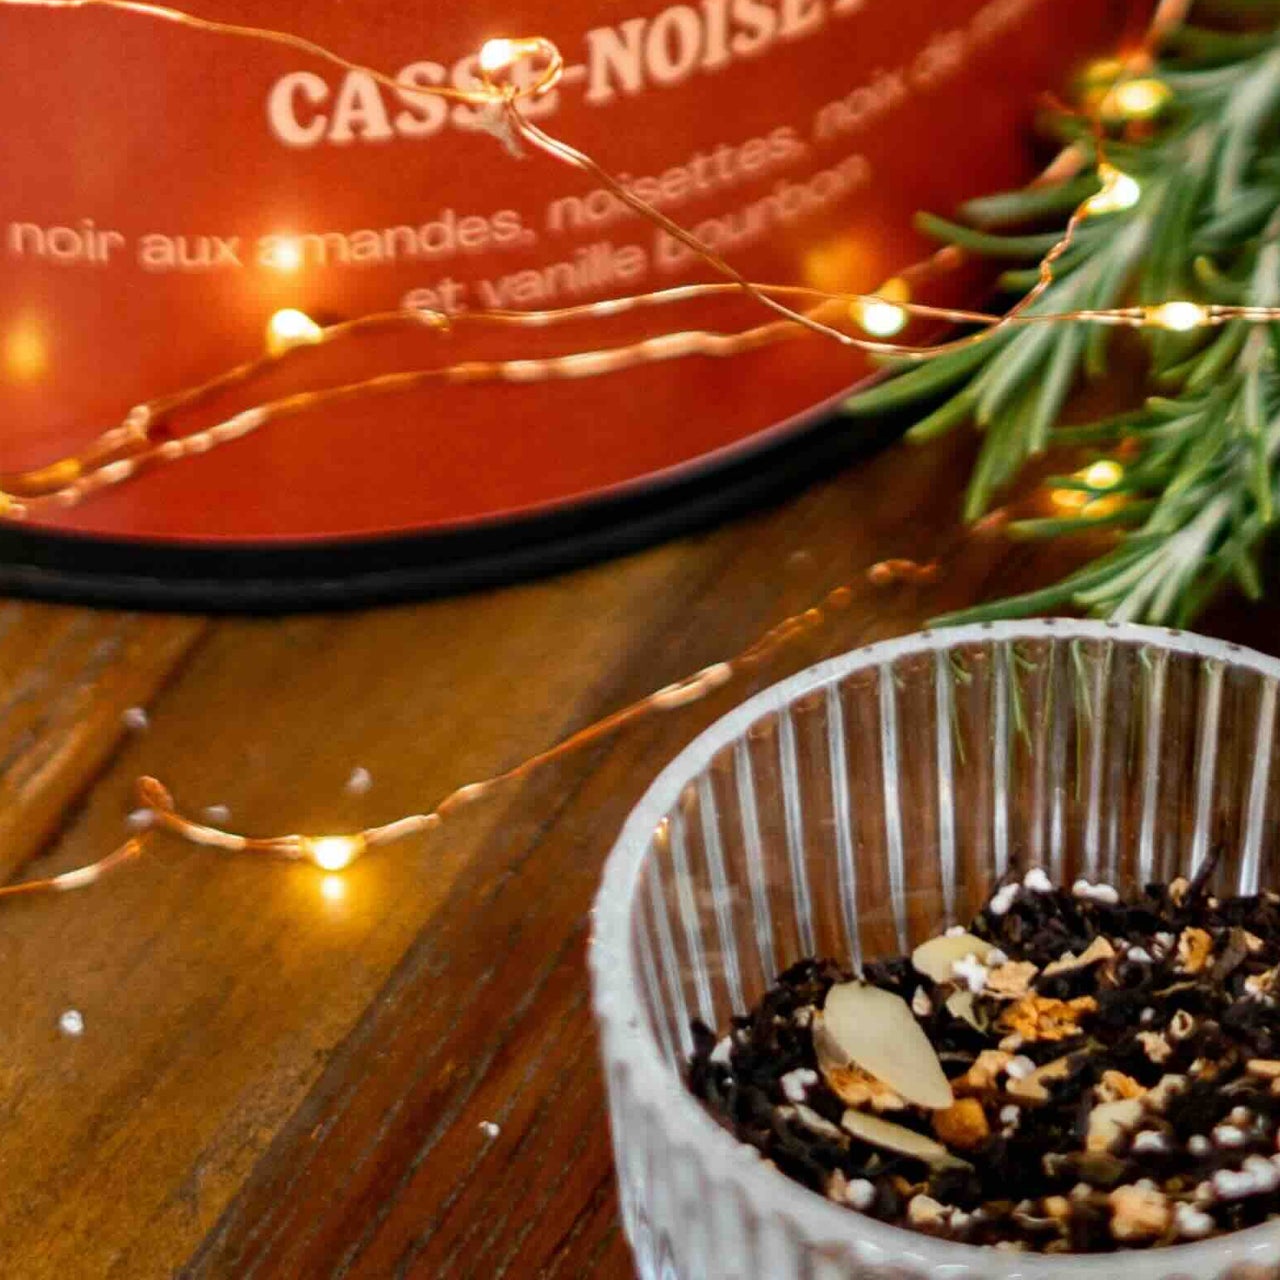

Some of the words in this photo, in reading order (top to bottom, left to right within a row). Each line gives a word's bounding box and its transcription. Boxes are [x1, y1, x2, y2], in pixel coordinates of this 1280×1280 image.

[10, 218, 125, 267] noir
[140, 233, 243, 272] aux
[402, 277, 466, 316] et
[478, 241, 647, 309] vanille
